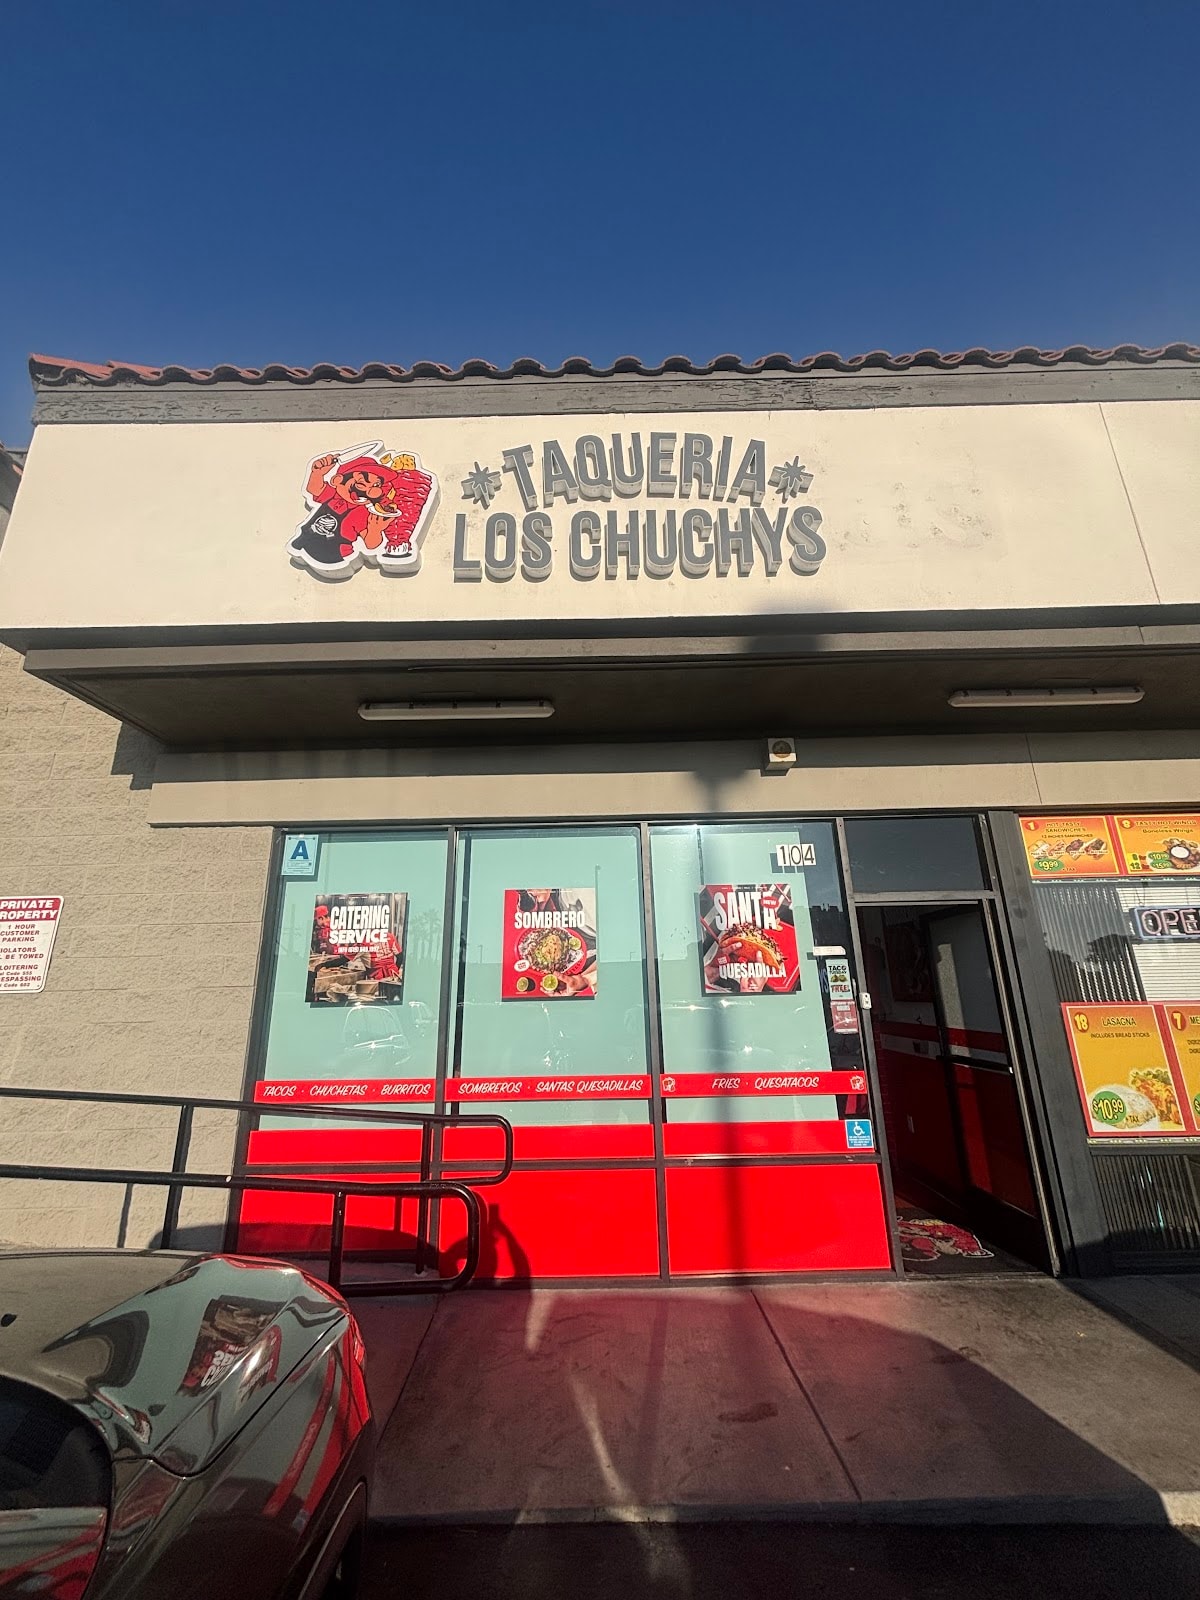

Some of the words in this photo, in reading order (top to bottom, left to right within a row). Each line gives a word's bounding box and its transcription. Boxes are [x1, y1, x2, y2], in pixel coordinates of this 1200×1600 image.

[502, 432, 767, 507] TAQUERIA
[453, 511, 552, 581] LOS
[571, 506, 827, 578] CHUCHYS
[1028, 821, 1035, 830] 1
[290, 840, 309, 860] A
[779, 845, 815, 864] 104
[1038, 861, 1059, 871] $9.99
[0, 900, 54, 910] PRIVATE
[0, 910, 57, 920] ROPERTY
[330, 904, 390, 929] CATERING
[514, 910, 585, 929] SOMBRERO
[1141, 909, 1200, 935] OPE
[328, 928, 389, 944] SERVICE
[1101, 1016, 1137, 1027] LASAGNA
[262, 1085, 297, 1098] TACOS
[309, 1084, 369, 1096] CHUCHETAS
[380, 1083, 432, 1096] BURRITOS
[458, 1082, 523, 1094] SOMBREROS
[535, 1081, 575, 1093] SANTAS
[576, 1080, 644, 1092] QUESADILLAS
[711, 1077, 741, 1089] FRIES
[754, 1076, 819, 1089] QUESATACOS
[1092, 1099, 1124, 1121] $10.99
